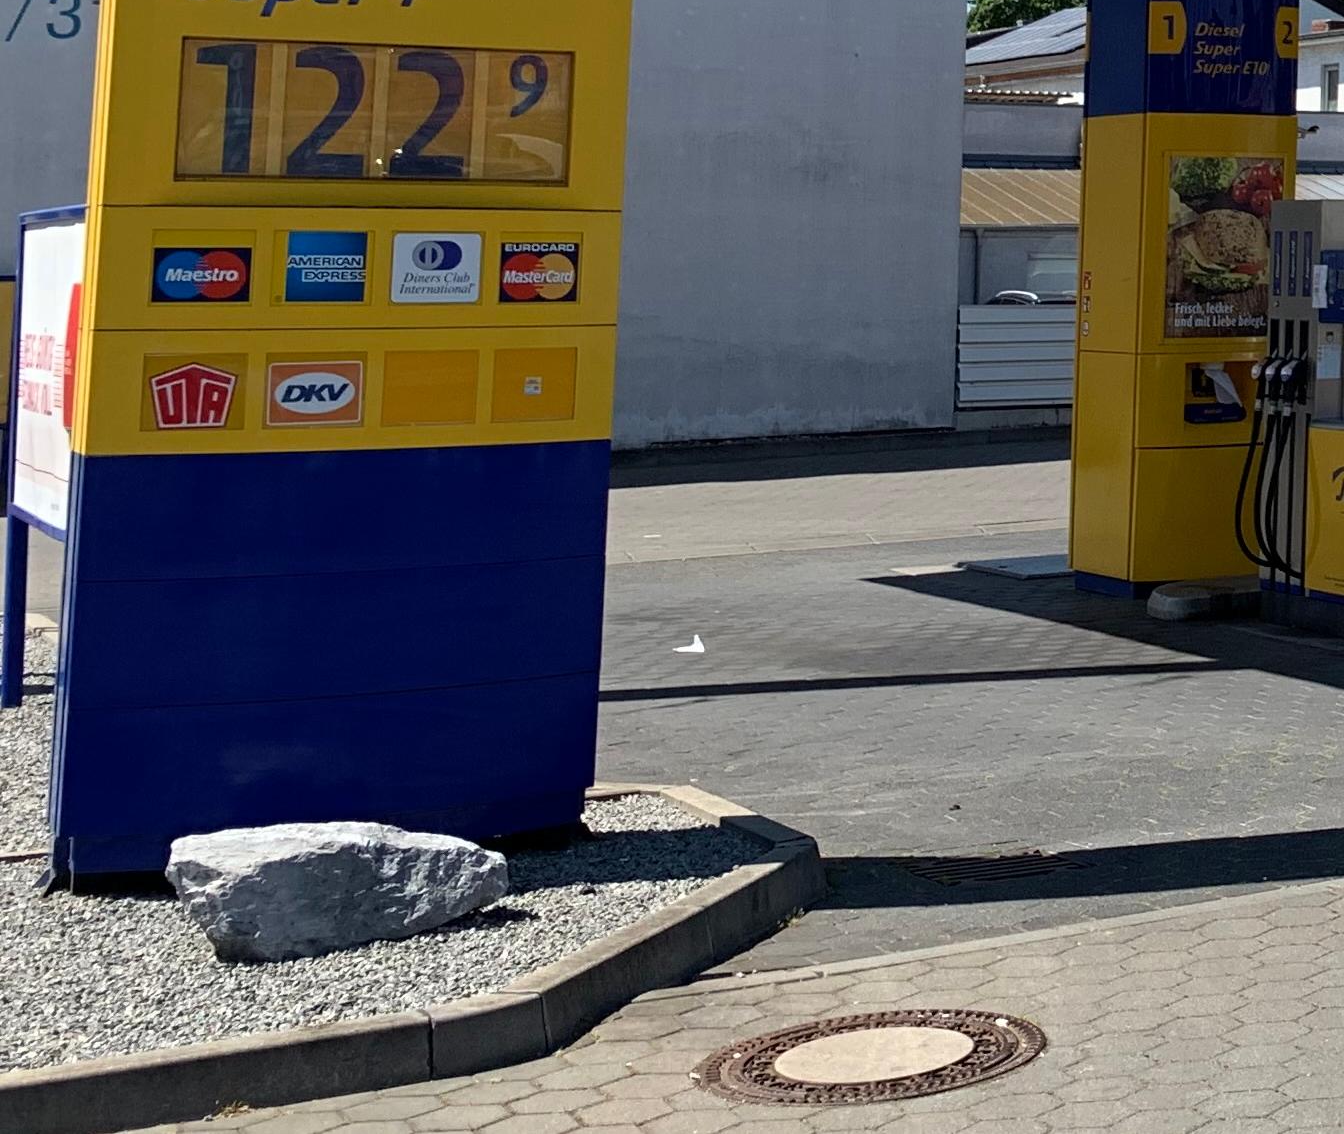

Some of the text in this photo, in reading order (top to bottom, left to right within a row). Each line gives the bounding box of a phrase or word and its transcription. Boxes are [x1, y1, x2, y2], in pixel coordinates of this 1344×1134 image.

[1163, 15, 1293, 45] 1 2
[1194, 22, 1246, 38] Diesel
[1193, 41, 1241, 60] Super
[1193, 60, 1270, 78] Super E10
[504, 243, 575, 252] EUROCARD
[288, 256, 362, 266] AMERICAN
[165, 268, 239, 282] Maestro
[302, 270, 366, 281] EXPRESS
[403, 272, 470, 283] Diners Club
[503, 270, 575, 284] MasterCard
[400, 283, 473, 294] International
[1175, 302, 1234, 316] Frisch, lecker
[1174, 314, 1266, 330] und mit Liebe belegt.
[154, 366, 234, 424] UTA
[281, 383, 350, 404] DKV
